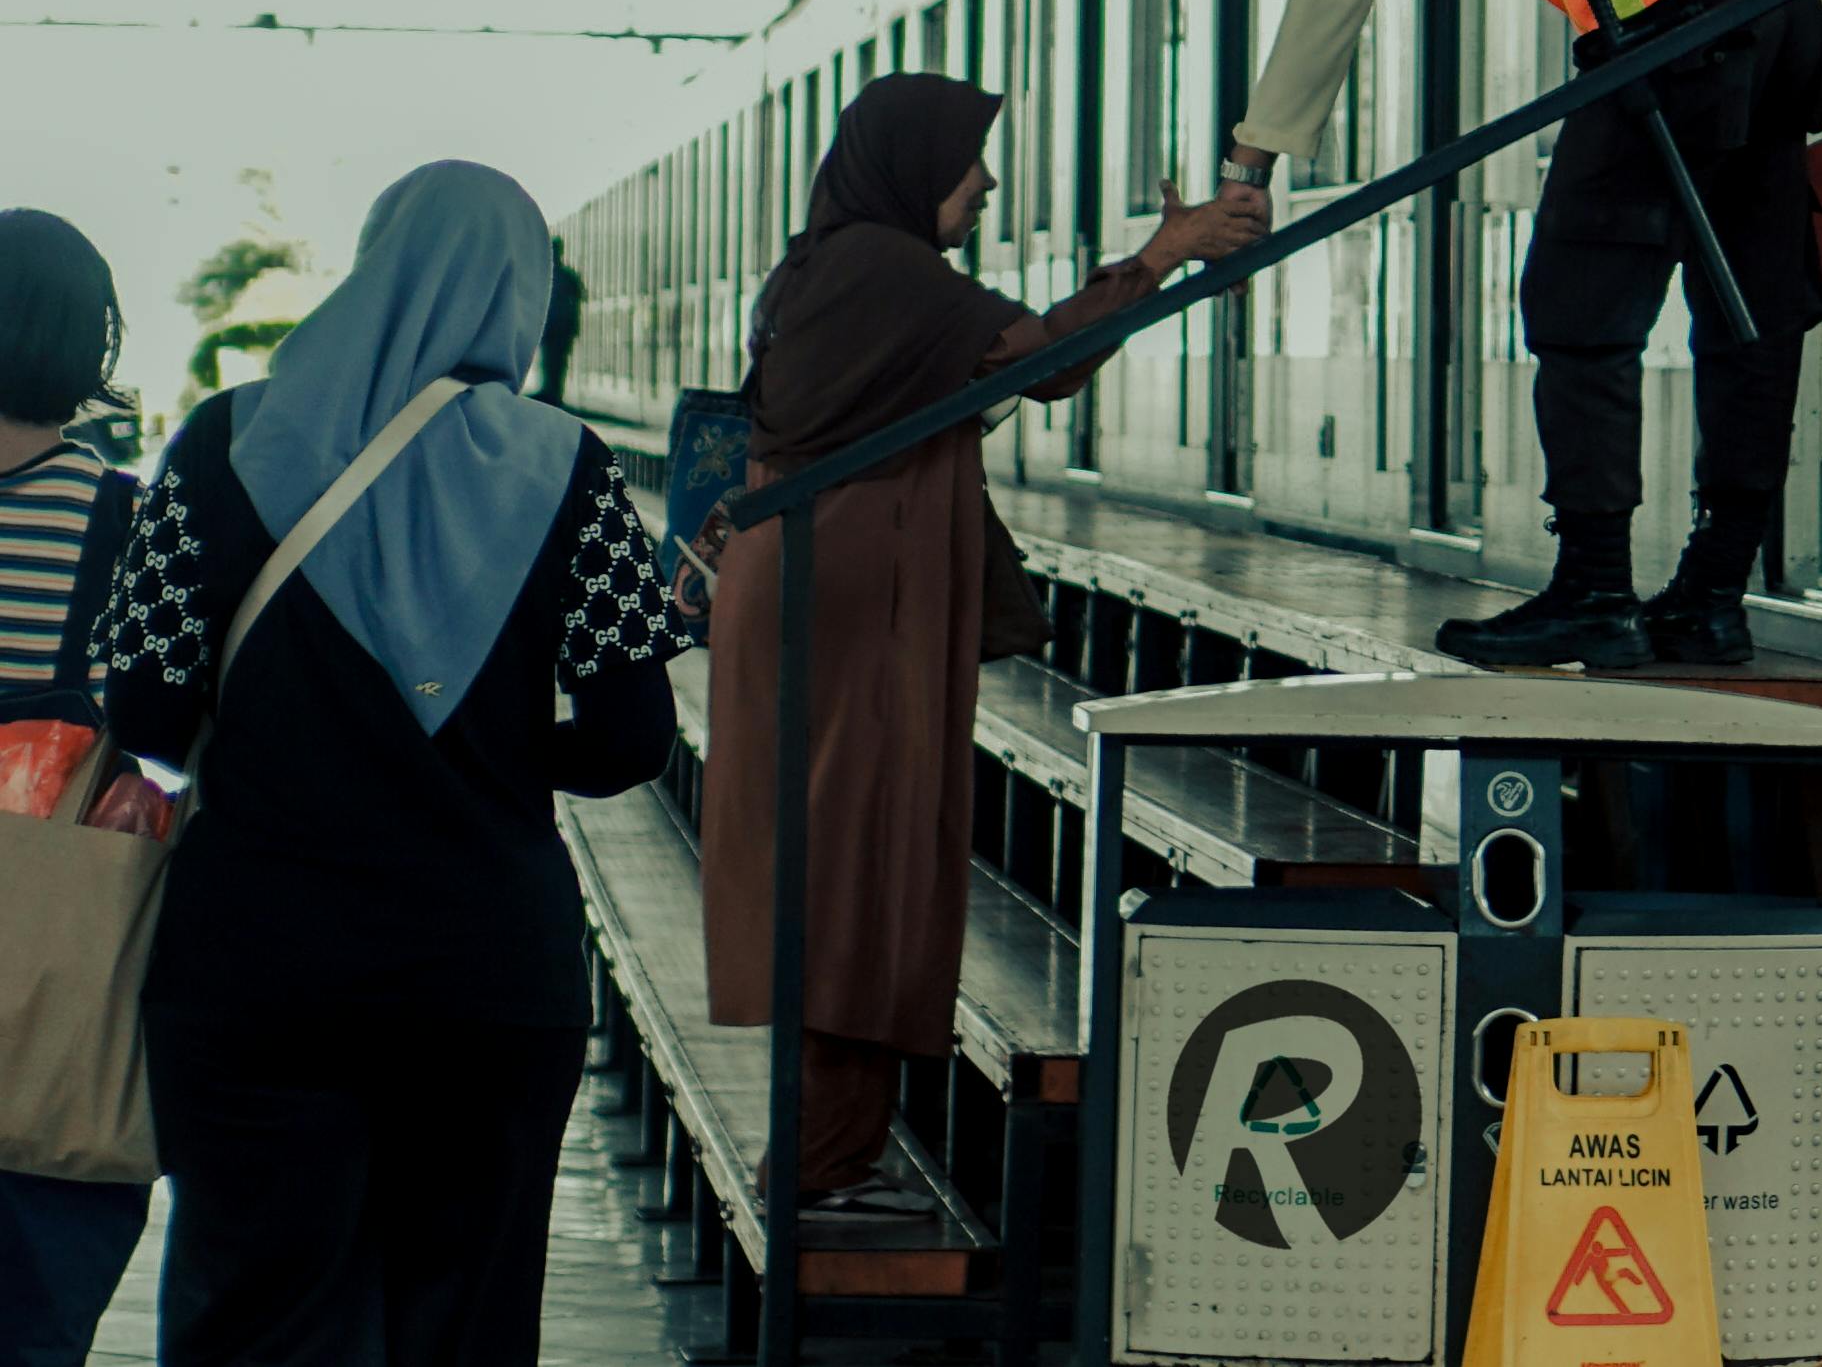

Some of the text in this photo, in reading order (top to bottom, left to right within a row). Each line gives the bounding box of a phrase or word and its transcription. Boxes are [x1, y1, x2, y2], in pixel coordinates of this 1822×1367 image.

[1569, 1134, 1641, 1159] AWAS
[1541, 1168, 1671, 1187] LANTAI LICIN
[1214, 1184, 1345, 1209] Recyclable
[1723, 1191, 1779, 1210] waste
